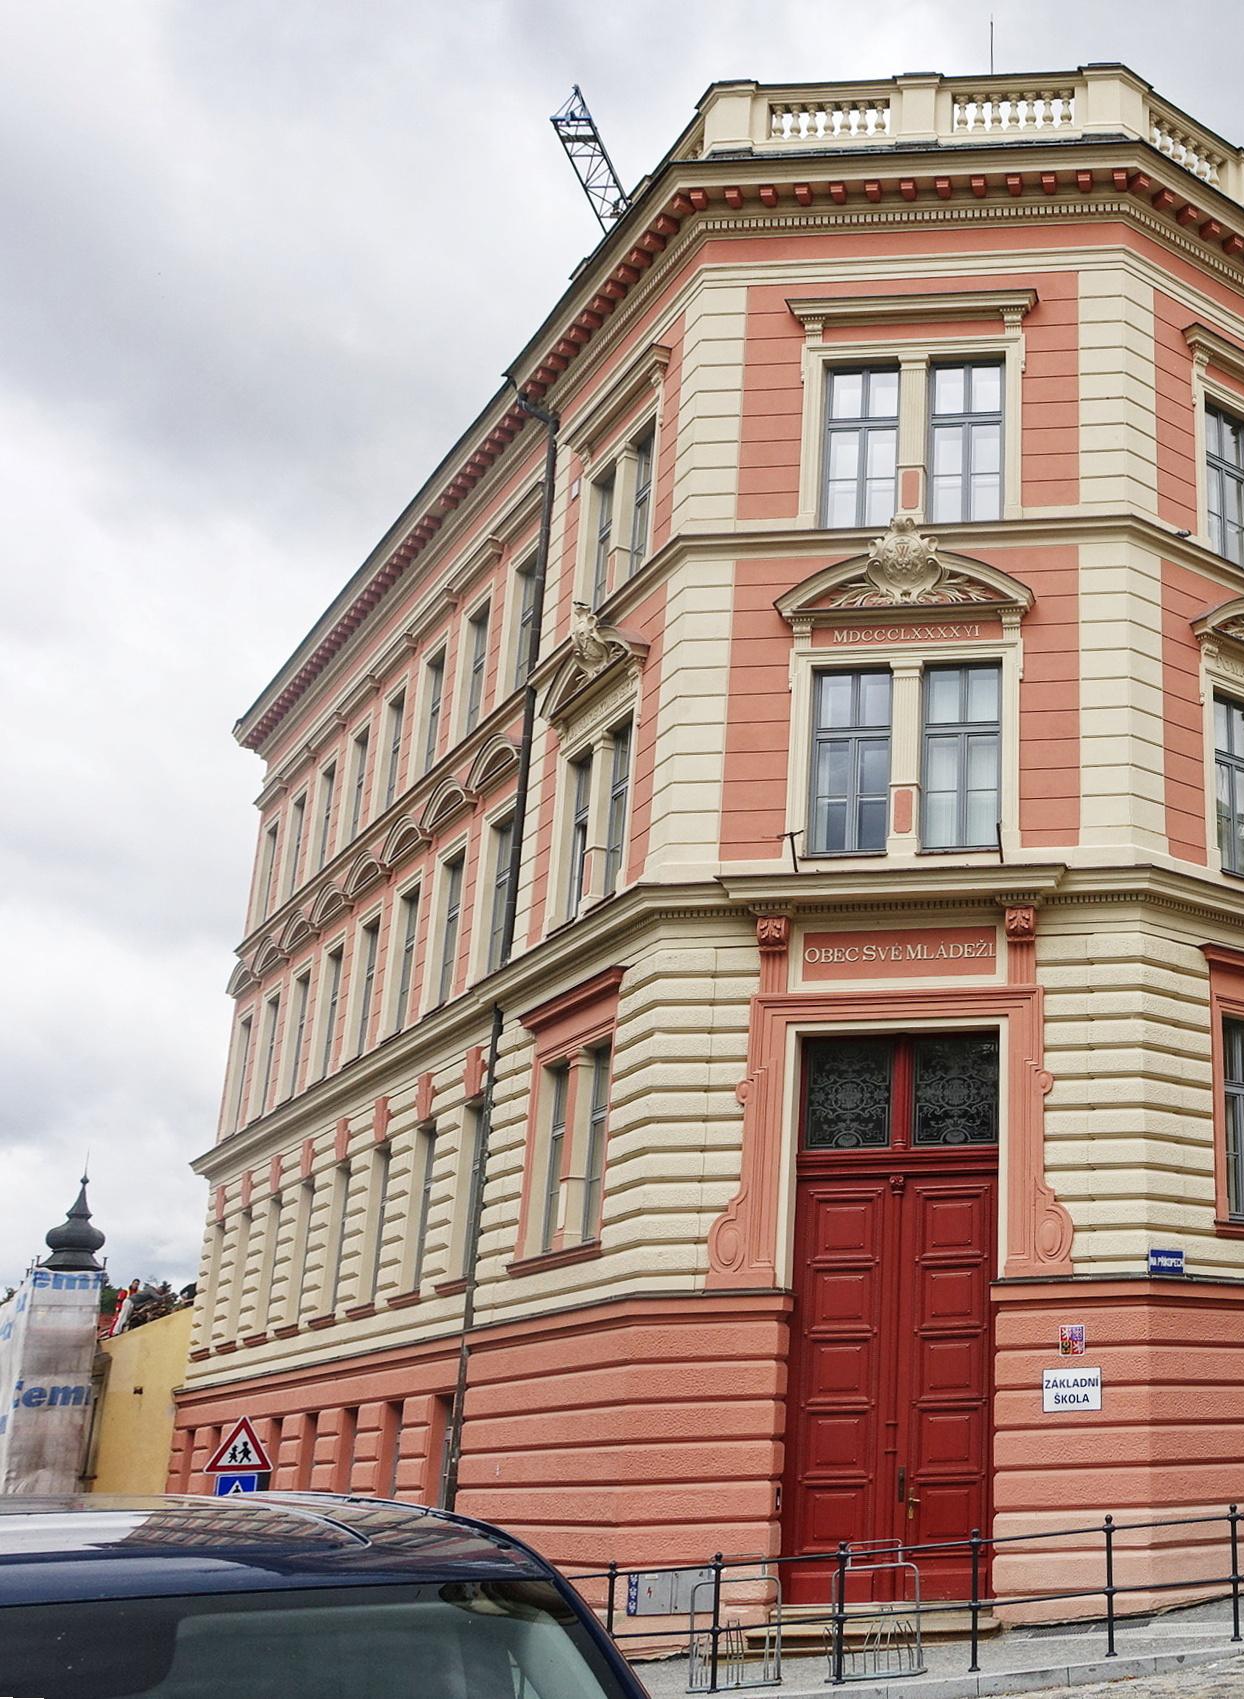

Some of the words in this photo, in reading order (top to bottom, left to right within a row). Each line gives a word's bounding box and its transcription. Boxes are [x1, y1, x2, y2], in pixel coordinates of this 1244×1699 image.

[804, 947, 859, 963] OBEC
[862, 943, 901, 961] SVÉ
[1045, 1377, 1099, 1389] ZÁKLADNÍ
[1054, 1393, 1090, 1404] ŠKOLA
